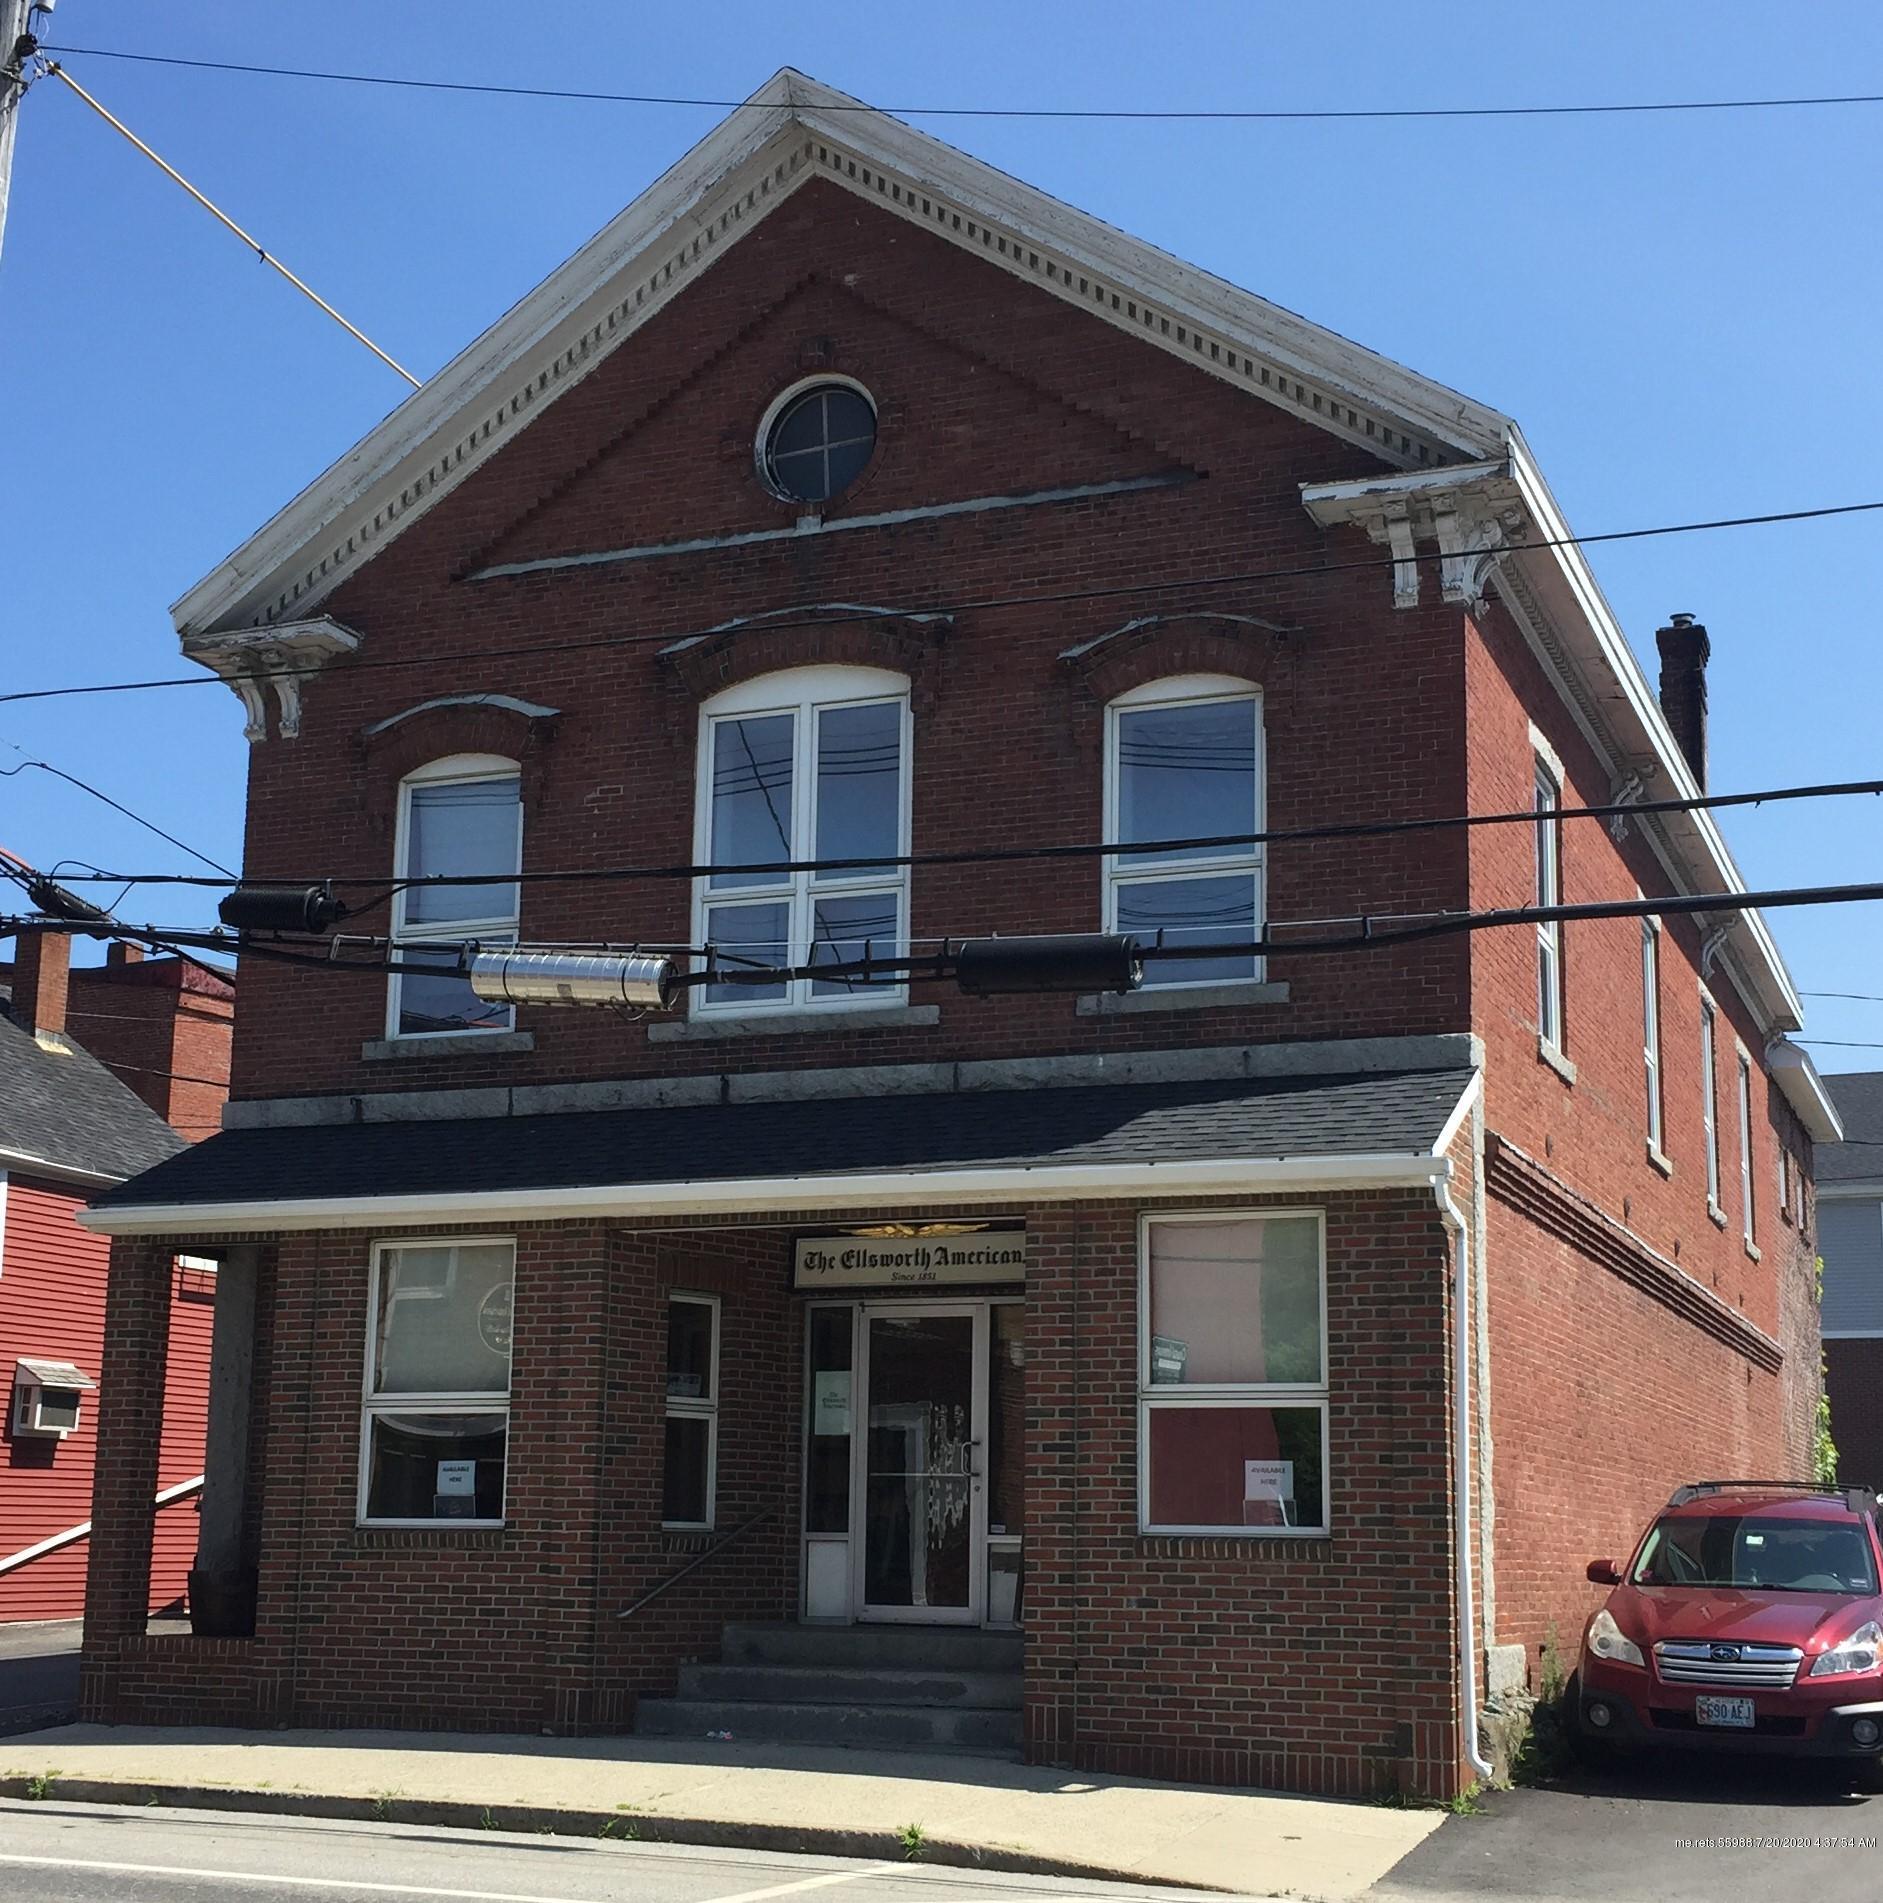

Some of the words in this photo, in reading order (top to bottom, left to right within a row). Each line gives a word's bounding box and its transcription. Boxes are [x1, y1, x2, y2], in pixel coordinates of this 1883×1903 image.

[804, 1251, 836, 1274] The
[841, 1248, 931, 1271] Ellsworth
[891, 1271, 915, 1281] Since
[918, 1271, 937, 1281] 1851
